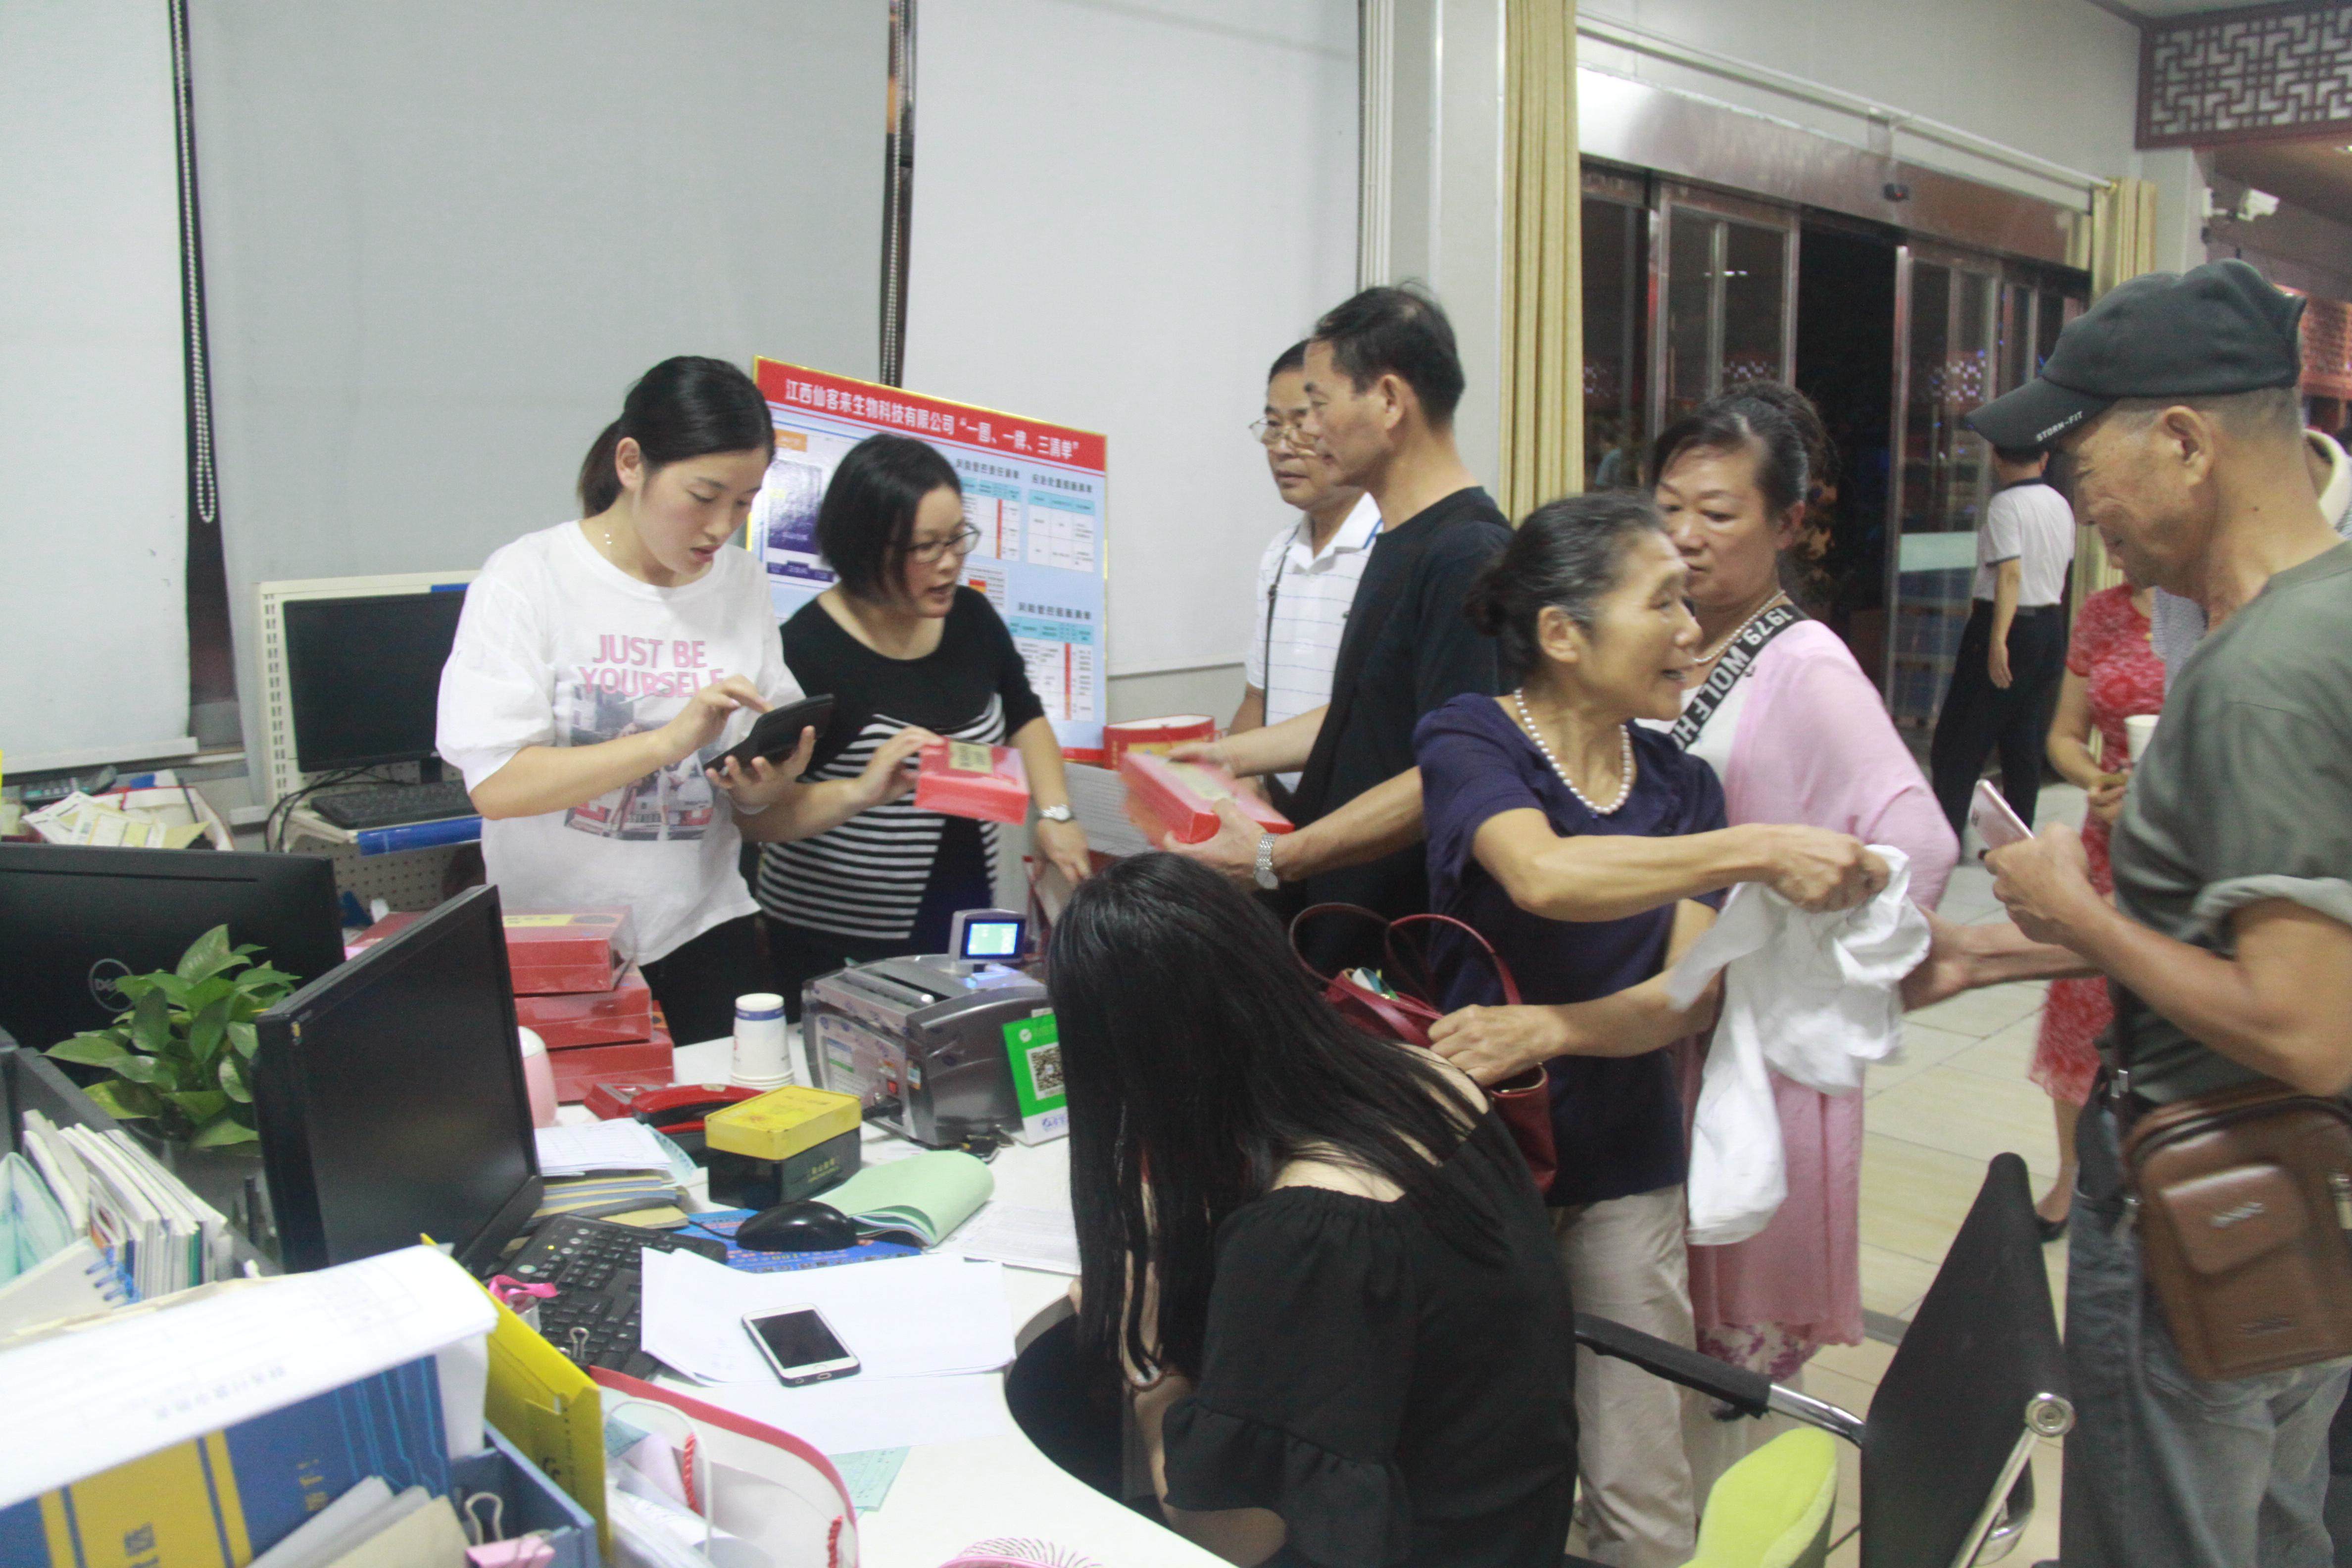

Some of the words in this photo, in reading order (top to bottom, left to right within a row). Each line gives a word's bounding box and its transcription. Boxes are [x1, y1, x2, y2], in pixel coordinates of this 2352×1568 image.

[2036, 410, 2083, 442] STORM-FIT
[592, 635, 664, 668] JUST
[674, 640, 707, 668] BE
